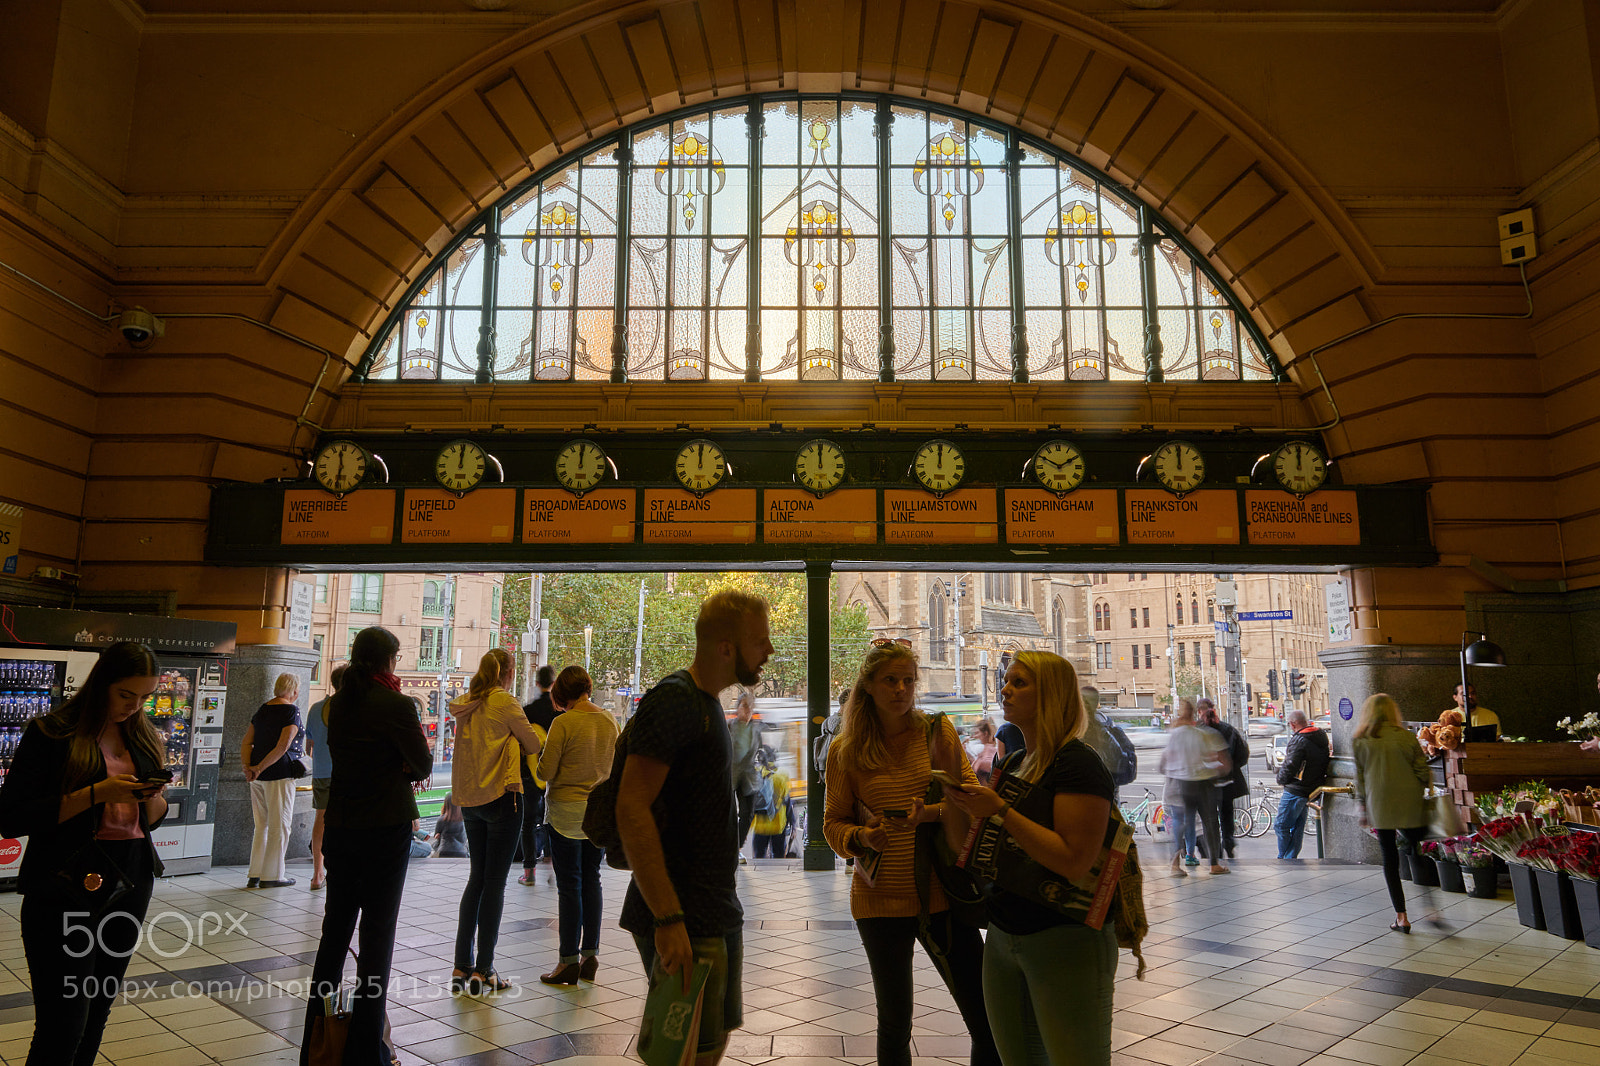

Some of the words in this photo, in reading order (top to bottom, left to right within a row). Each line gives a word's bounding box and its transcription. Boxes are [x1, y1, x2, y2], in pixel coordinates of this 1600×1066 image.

[290, 500, 348, 512] WERRIBEE
[409, 499, 456, 511] UPFIELD
[530, 499, 627, 511] BROADMEADOWS
[650, 500, 666, 511] ST
[667, 500, 711, 511] ALBANS
[770, 500, 815, 511] ALTONA
[891, 500, 977, 511] WILLIAMSTOWN
[1011, 500, 1094, 511] SANDRINGHAM
[1131, 500, 1198, 512] FRANKSTON
[1251, 501, 1306, 512] PAKENHAM
[1311, 501, 1328, 512] and
[288, 511, 314, 523] LINE
[408, 511, 433, 522] LINE
[529, 511, 554, 522] LINE
[650, 511, 674, 523] LINE
[770, 511, 795, 522] LINE
[891, 511, 916, 523] LINE
[1012, 511, 1037, 522] LINE
[1131, 511, 1156, 522] LINE
[1251, 511, 1321, 523] CRANBOURNE
[1324, 512, 1353, 523] LINES
[408, 529, 451, 538] PLATFORM
[528, 530, 571, 538] PLATFORM
[649, 530, 692, 538] PLATFORM
[770, 530, 813, 538] PLATFORM
[891, 530, 934, 539] PLATFORM
[1012, 530, 1055, 538] PLATFORM
[1132, 530, 1175, 538] PLATFORM
[1253, 530, 1296, 539] PLATFORM
[1284, 610, 1291, 618] St
[98, 635, 152, 644] COMMUTE
[158, 638, 215, 648] REFRESHED
